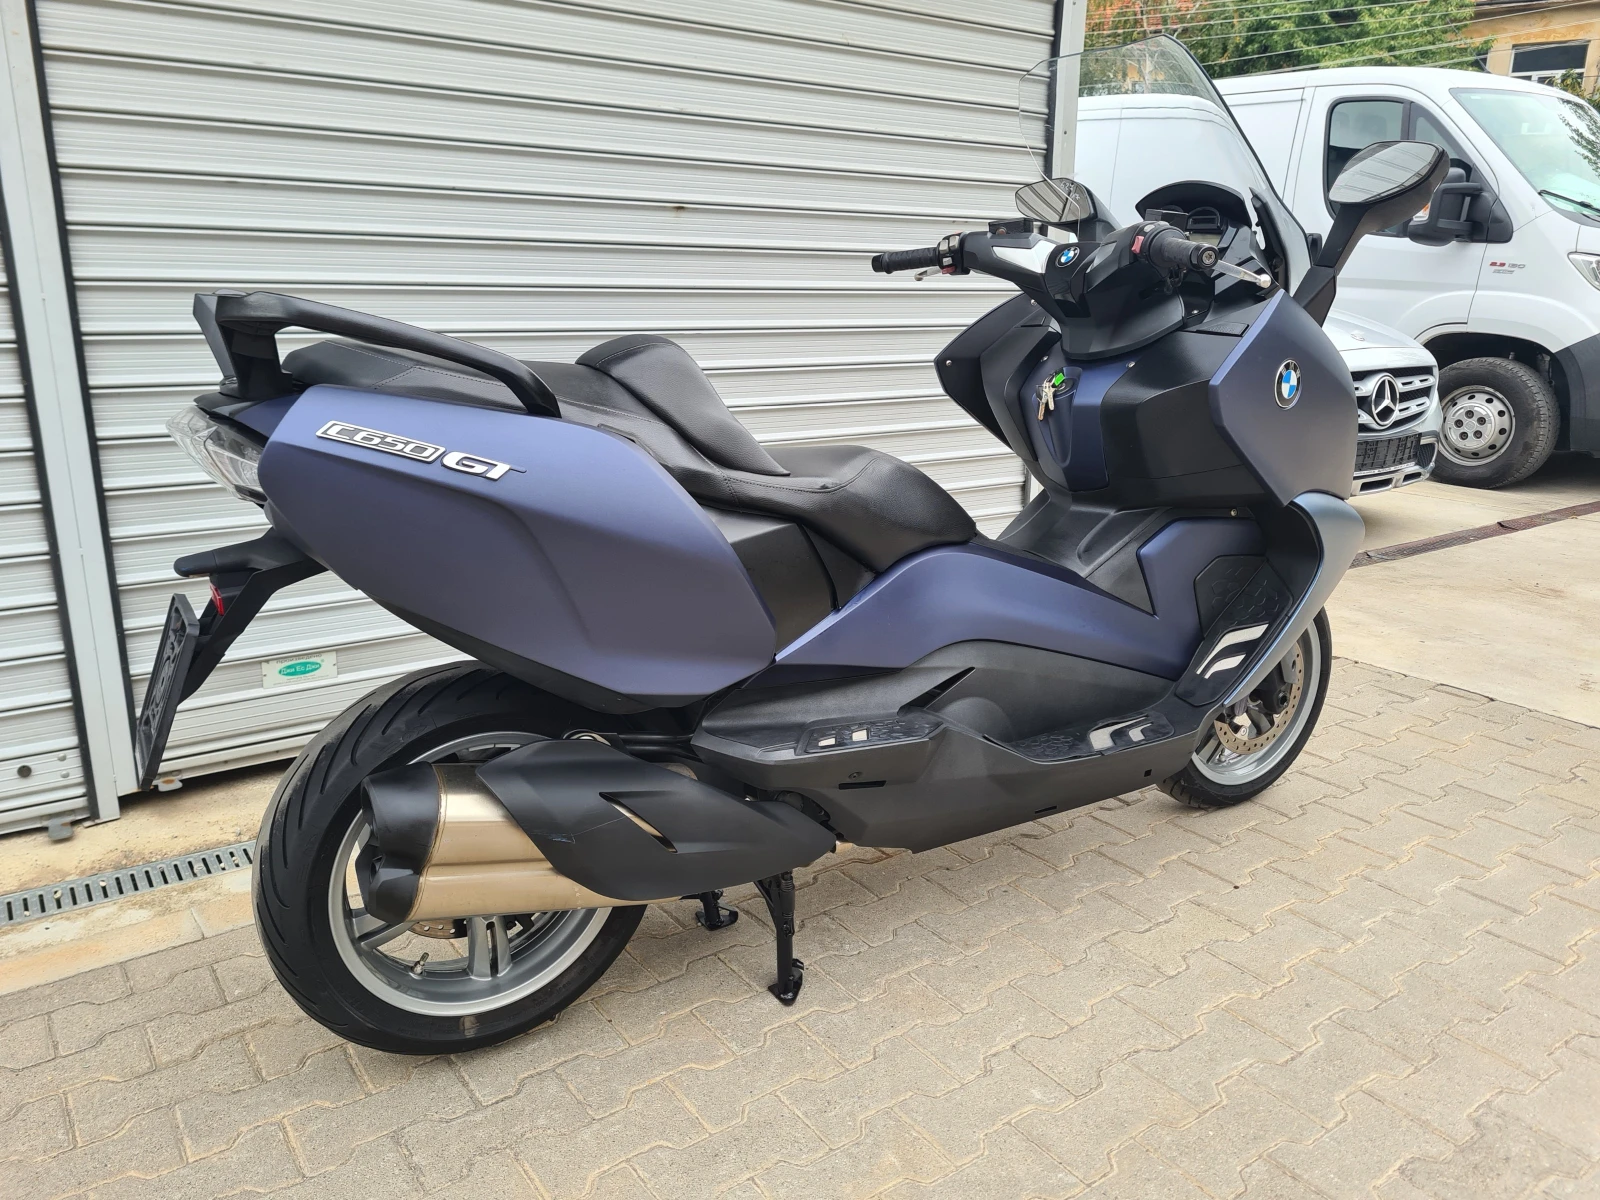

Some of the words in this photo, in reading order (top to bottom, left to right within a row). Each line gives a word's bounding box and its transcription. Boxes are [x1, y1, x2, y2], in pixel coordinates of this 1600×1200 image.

[440, 451, 524, 480] GT
[280, 667, 295, 675] Джи
[306, 663, 320, 671] Джи
